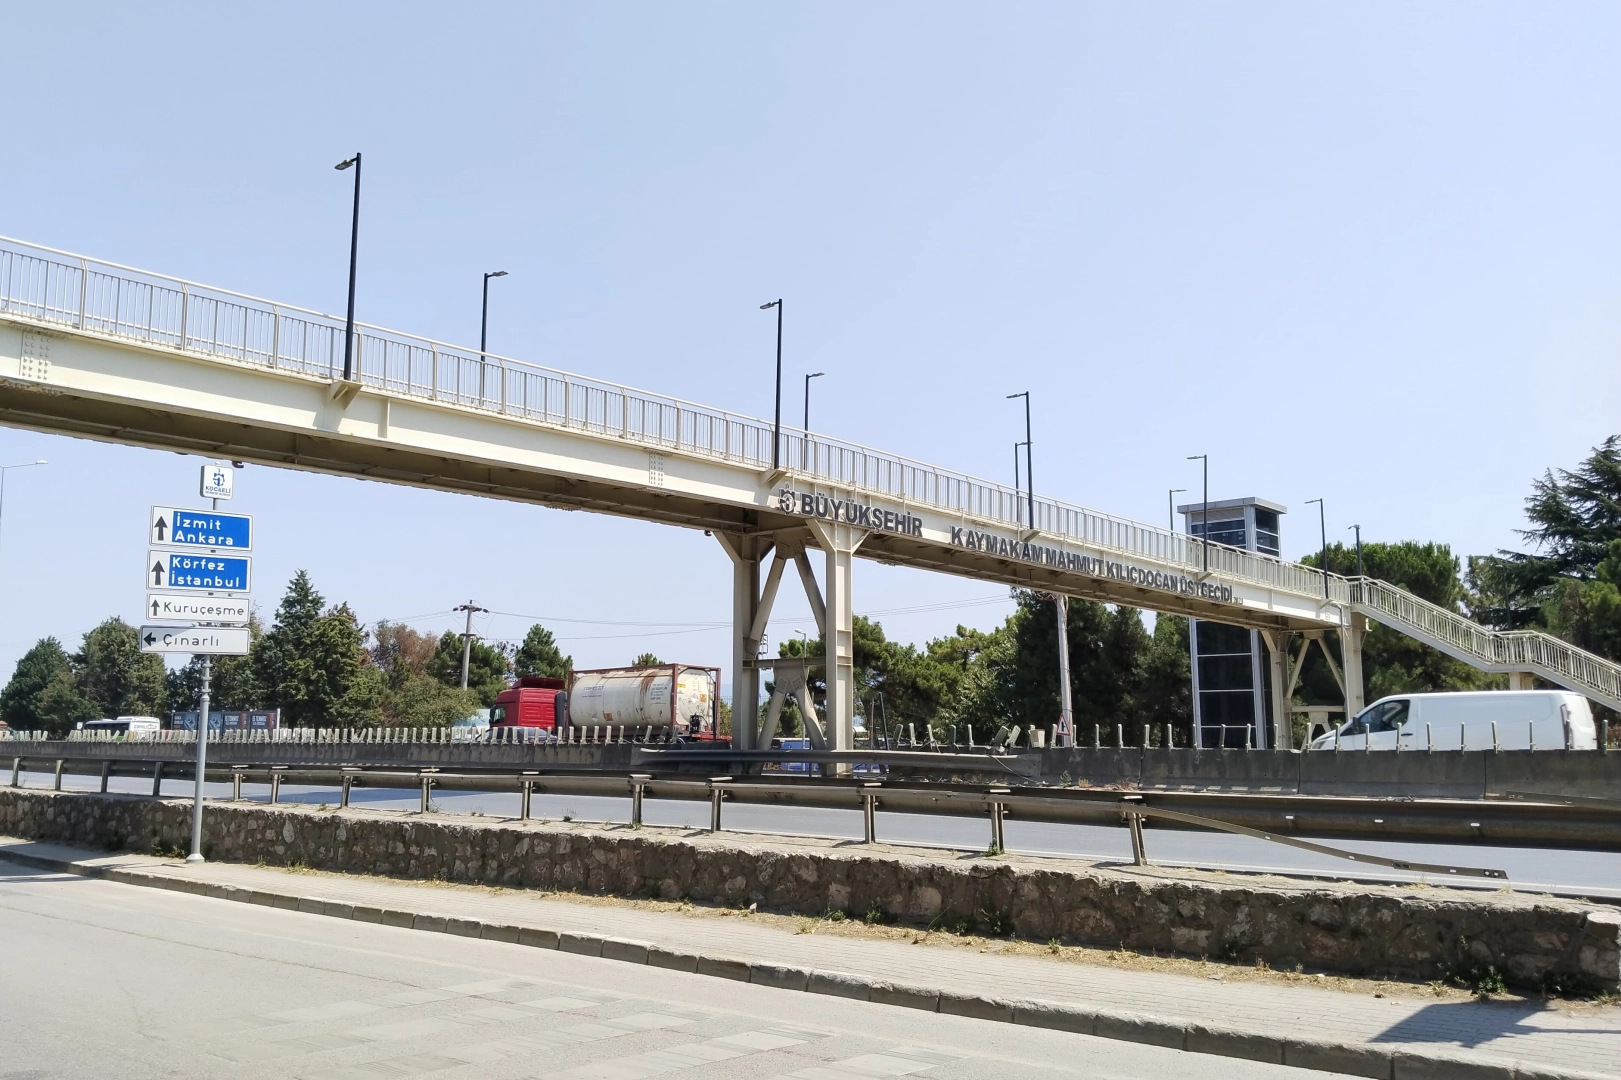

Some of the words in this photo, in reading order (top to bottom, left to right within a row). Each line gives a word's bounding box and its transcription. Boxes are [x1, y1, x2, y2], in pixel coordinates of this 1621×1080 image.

[176, 513, 221, 530] İzmit
[801, 491, 923, 538] BÜYÜKŞEHİR
[175, 530, 234, 546] Ankara
[951, 525, 1043, 564] KAYMAKAM
[1045, 547, 1105, 576] MAHMUT
[172, 556, 225, 571] Körfez
[171, 570, 240, 588] İstanbul
[163, 601, 245, 616] Kuruçeşme
[163, 633, 219, 648] Çınarlı
